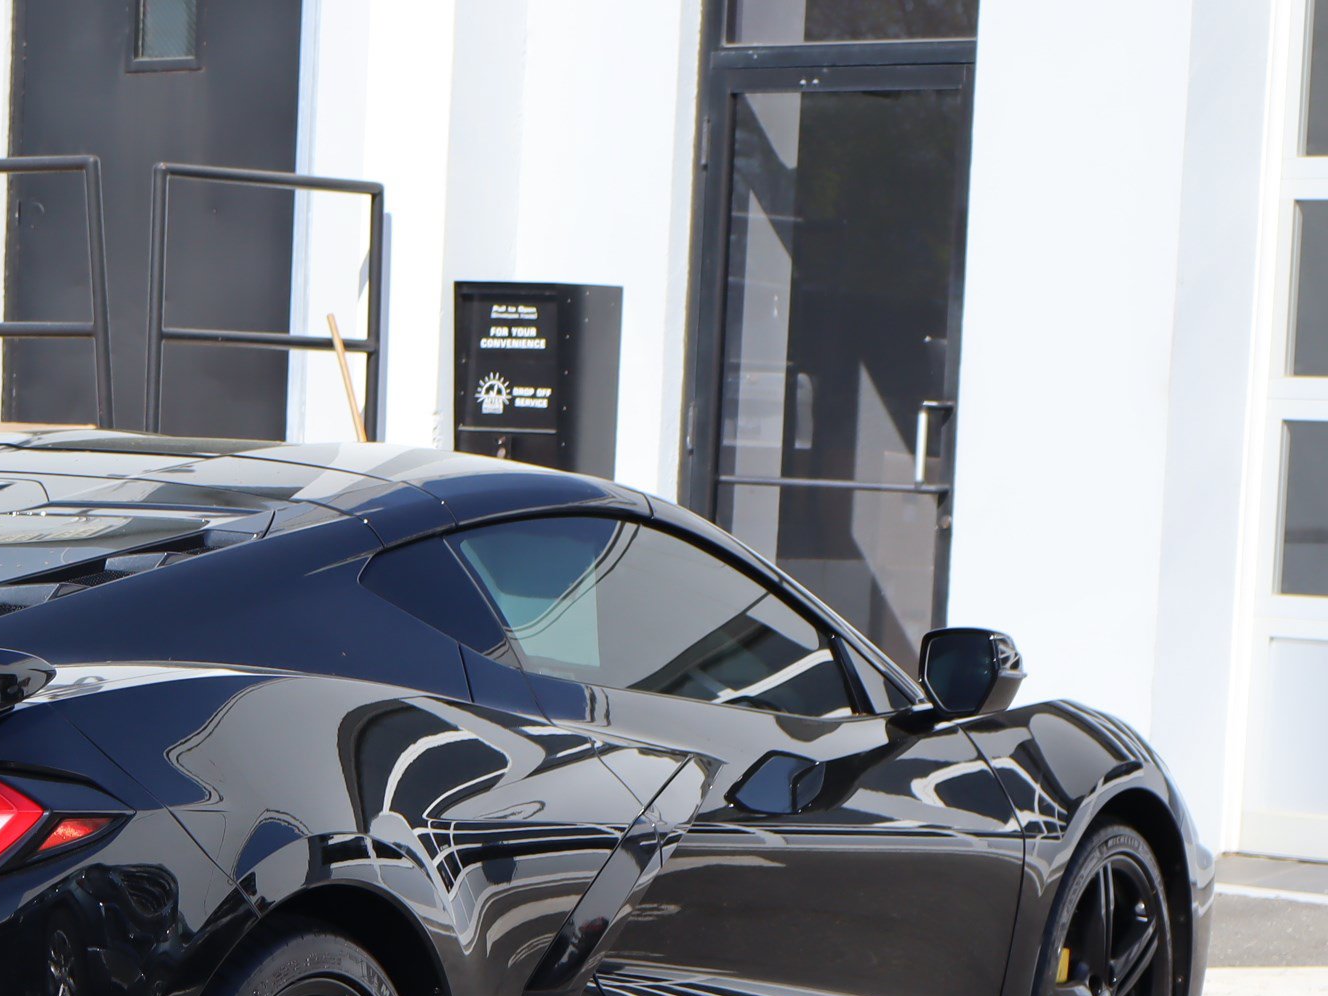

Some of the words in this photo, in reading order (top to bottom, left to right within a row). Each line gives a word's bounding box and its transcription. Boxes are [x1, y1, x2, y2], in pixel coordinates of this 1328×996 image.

[490, 327, 509, 337] FOR
[511, 327, 537, 337] YOUR
[480, 338, 546, 349] CONVENIENCE
[512, 387, 534, 397] DROP
[536, 388, 552, 397] OFF
[515, 398, 548, 408] SERVICE
